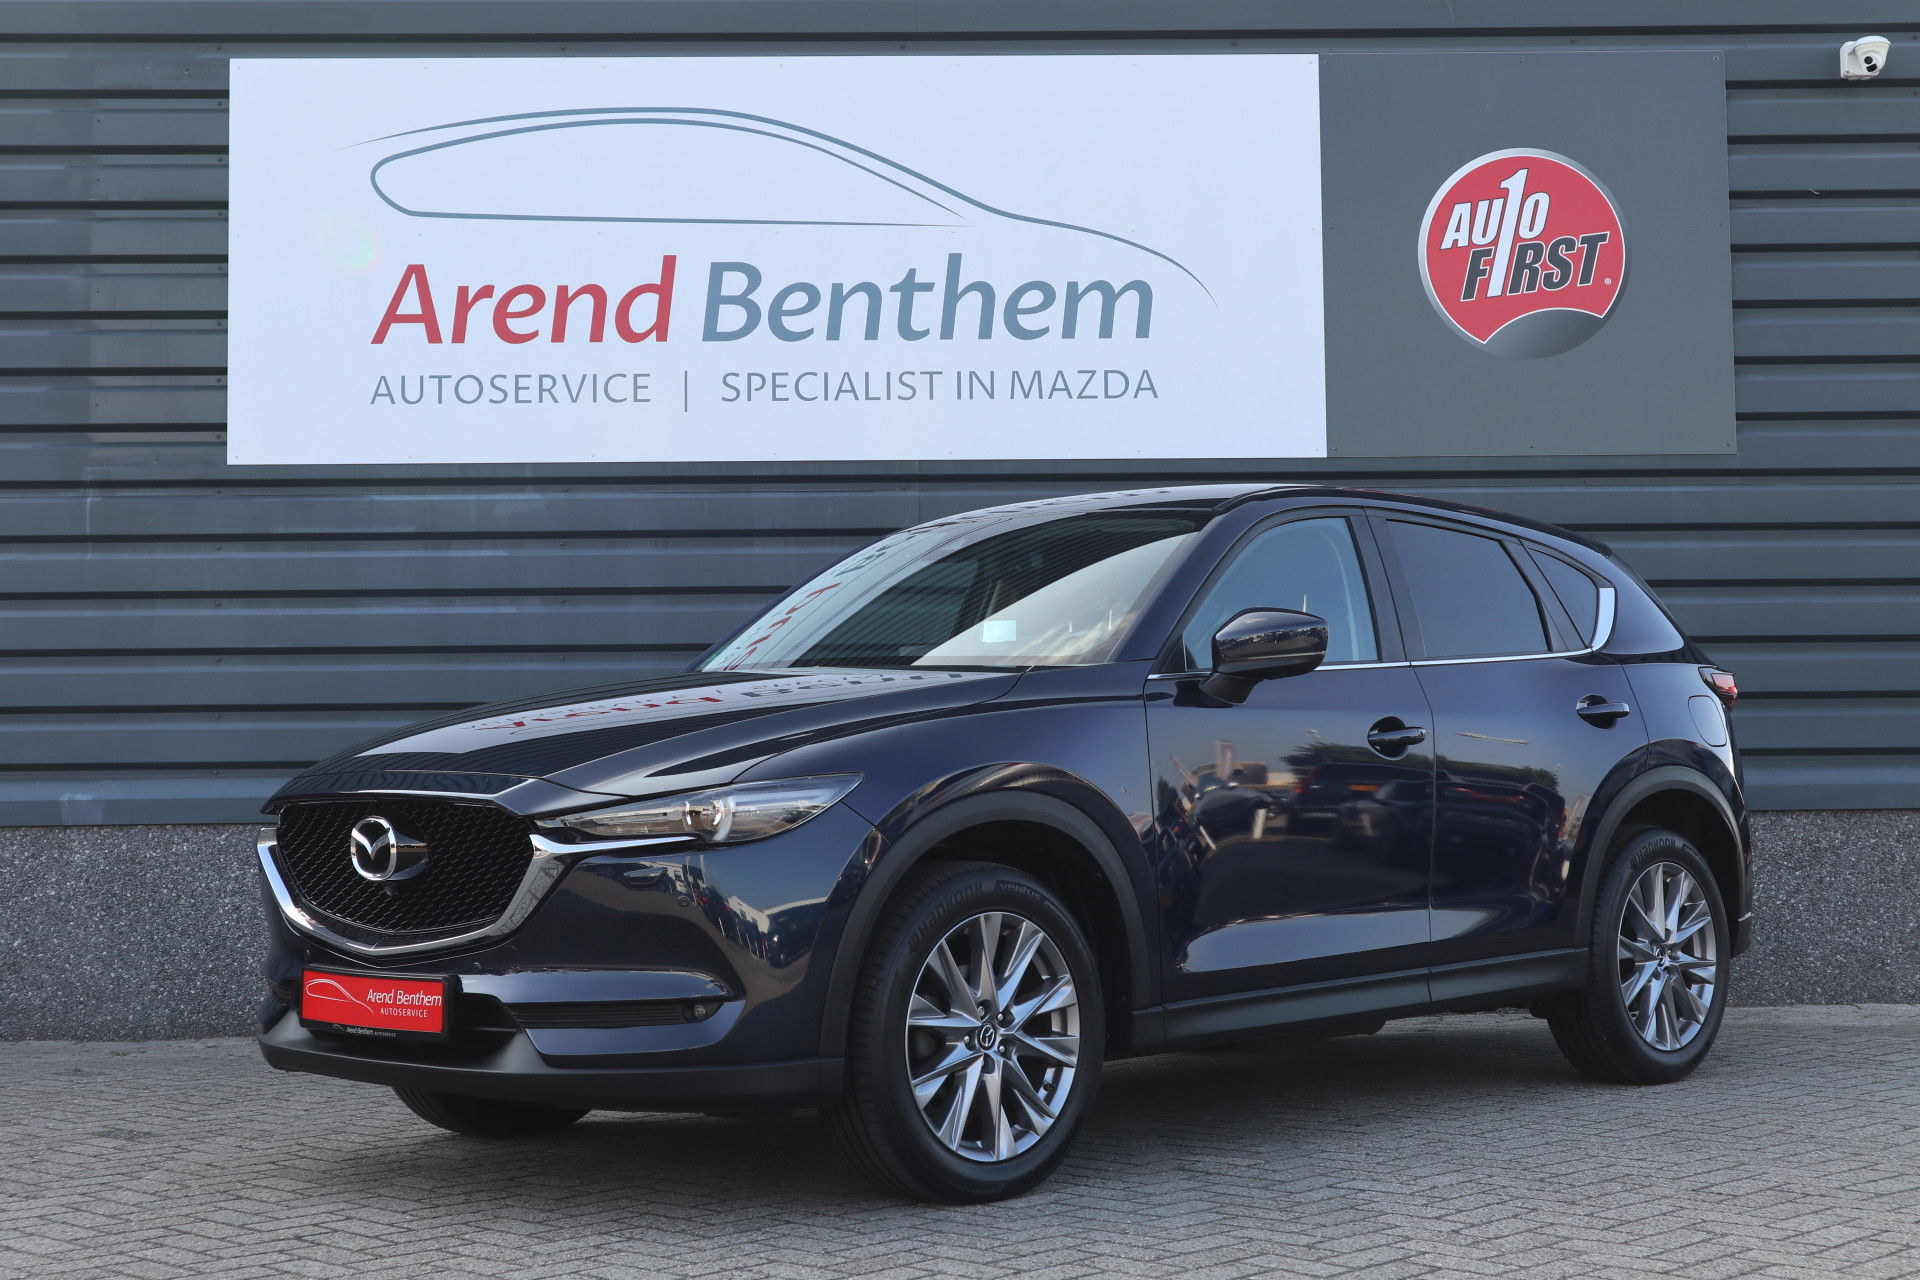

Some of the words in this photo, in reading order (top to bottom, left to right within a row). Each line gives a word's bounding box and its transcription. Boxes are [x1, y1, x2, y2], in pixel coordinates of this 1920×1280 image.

[371, 255, 677, 344] Arend
[702, 253, 1153, 342] Benthem
[370, 373, 651, 405] AUTOSERVICE
[721, 370, 943, 402] SPECIALIST
[956, 371, 995, 400] IN
[1009, 370, 1158, 399] MAZDA
[366, 988, 395, 1004] Arend
[396, 990, 442, 1006] Benthem
[380, 1007, 428, 1017] AUTOSERVICE
